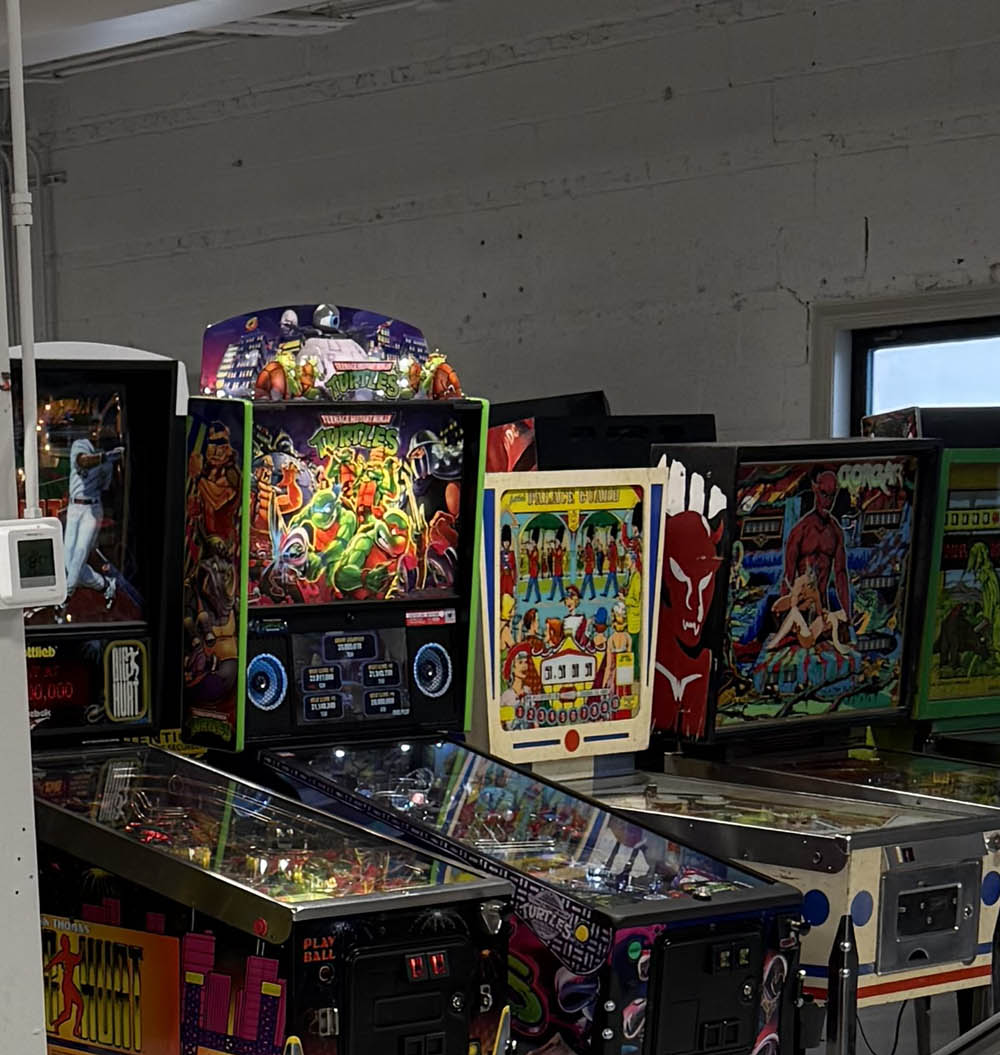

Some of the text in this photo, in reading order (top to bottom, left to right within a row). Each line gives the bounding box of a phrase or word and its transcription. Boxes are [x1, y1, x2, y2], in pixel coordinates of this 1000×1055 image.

[326, 371, 400, 400] TURTLES
[309, 424, 400, 456] TURTLES
[520, 902, 572, 940] TURTLES
[304, 936, 336, 950] PLAY
[304, 950, 336, 963] BALL
